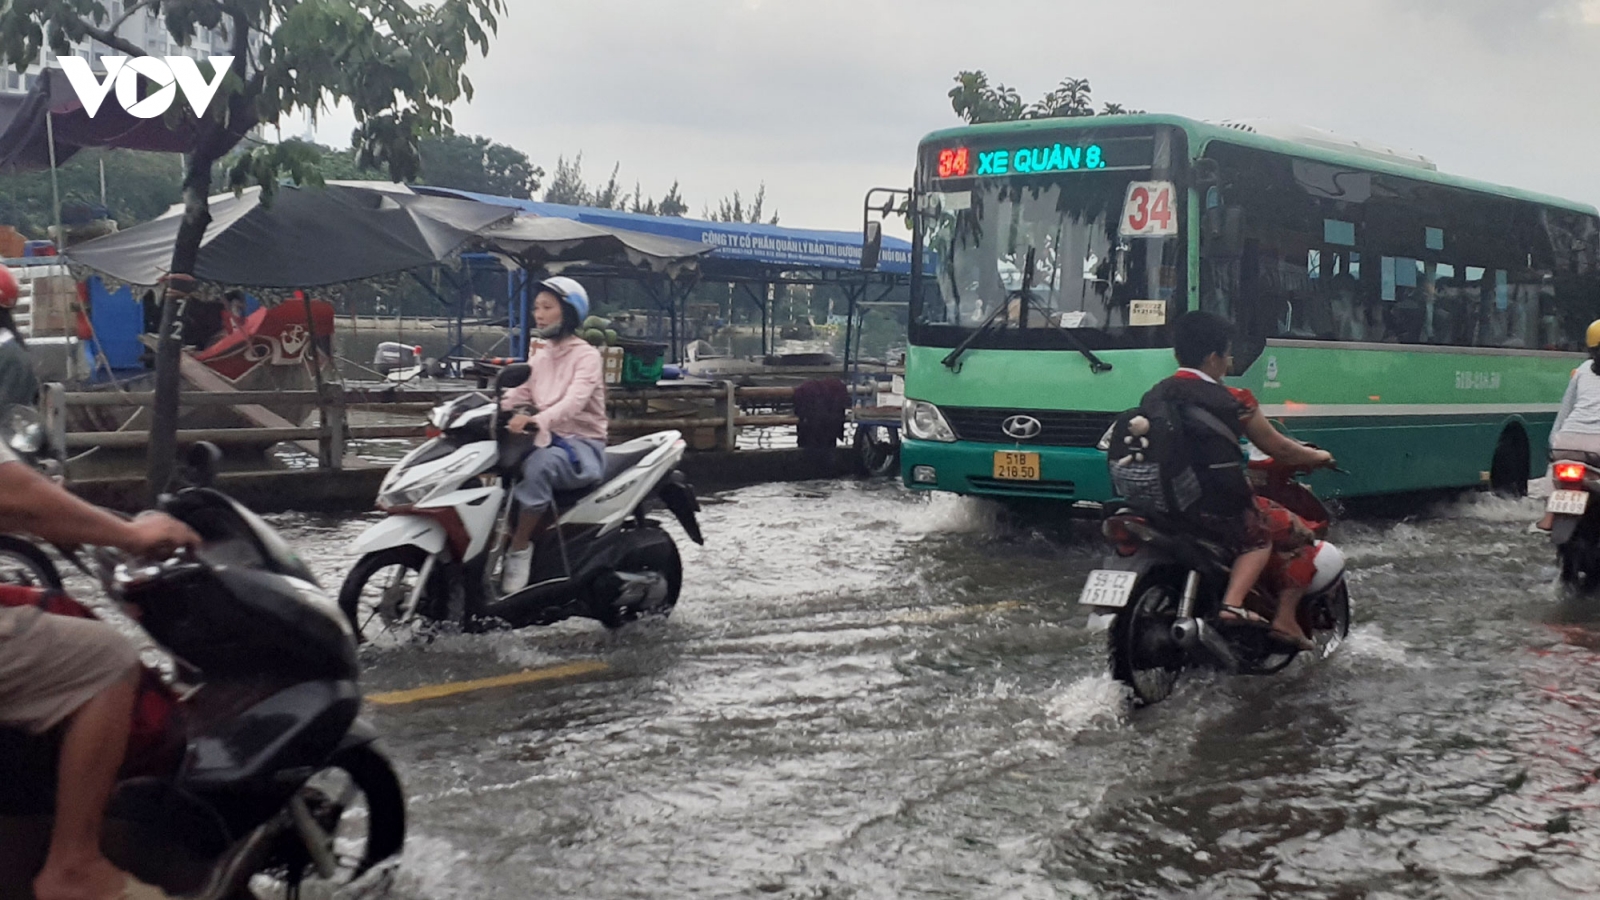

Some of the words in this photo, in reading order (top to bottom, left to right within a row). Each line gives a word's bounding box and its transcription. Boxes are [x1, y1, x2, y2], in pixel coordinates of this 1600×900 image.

[938, 147, 969, 178] 34
[977, 152, 1008, 175] XE
[1128, 186, 1171, 231] 34
[727, 234, 739, 247] TY
[1006, 453, 1026, 465] 51B
